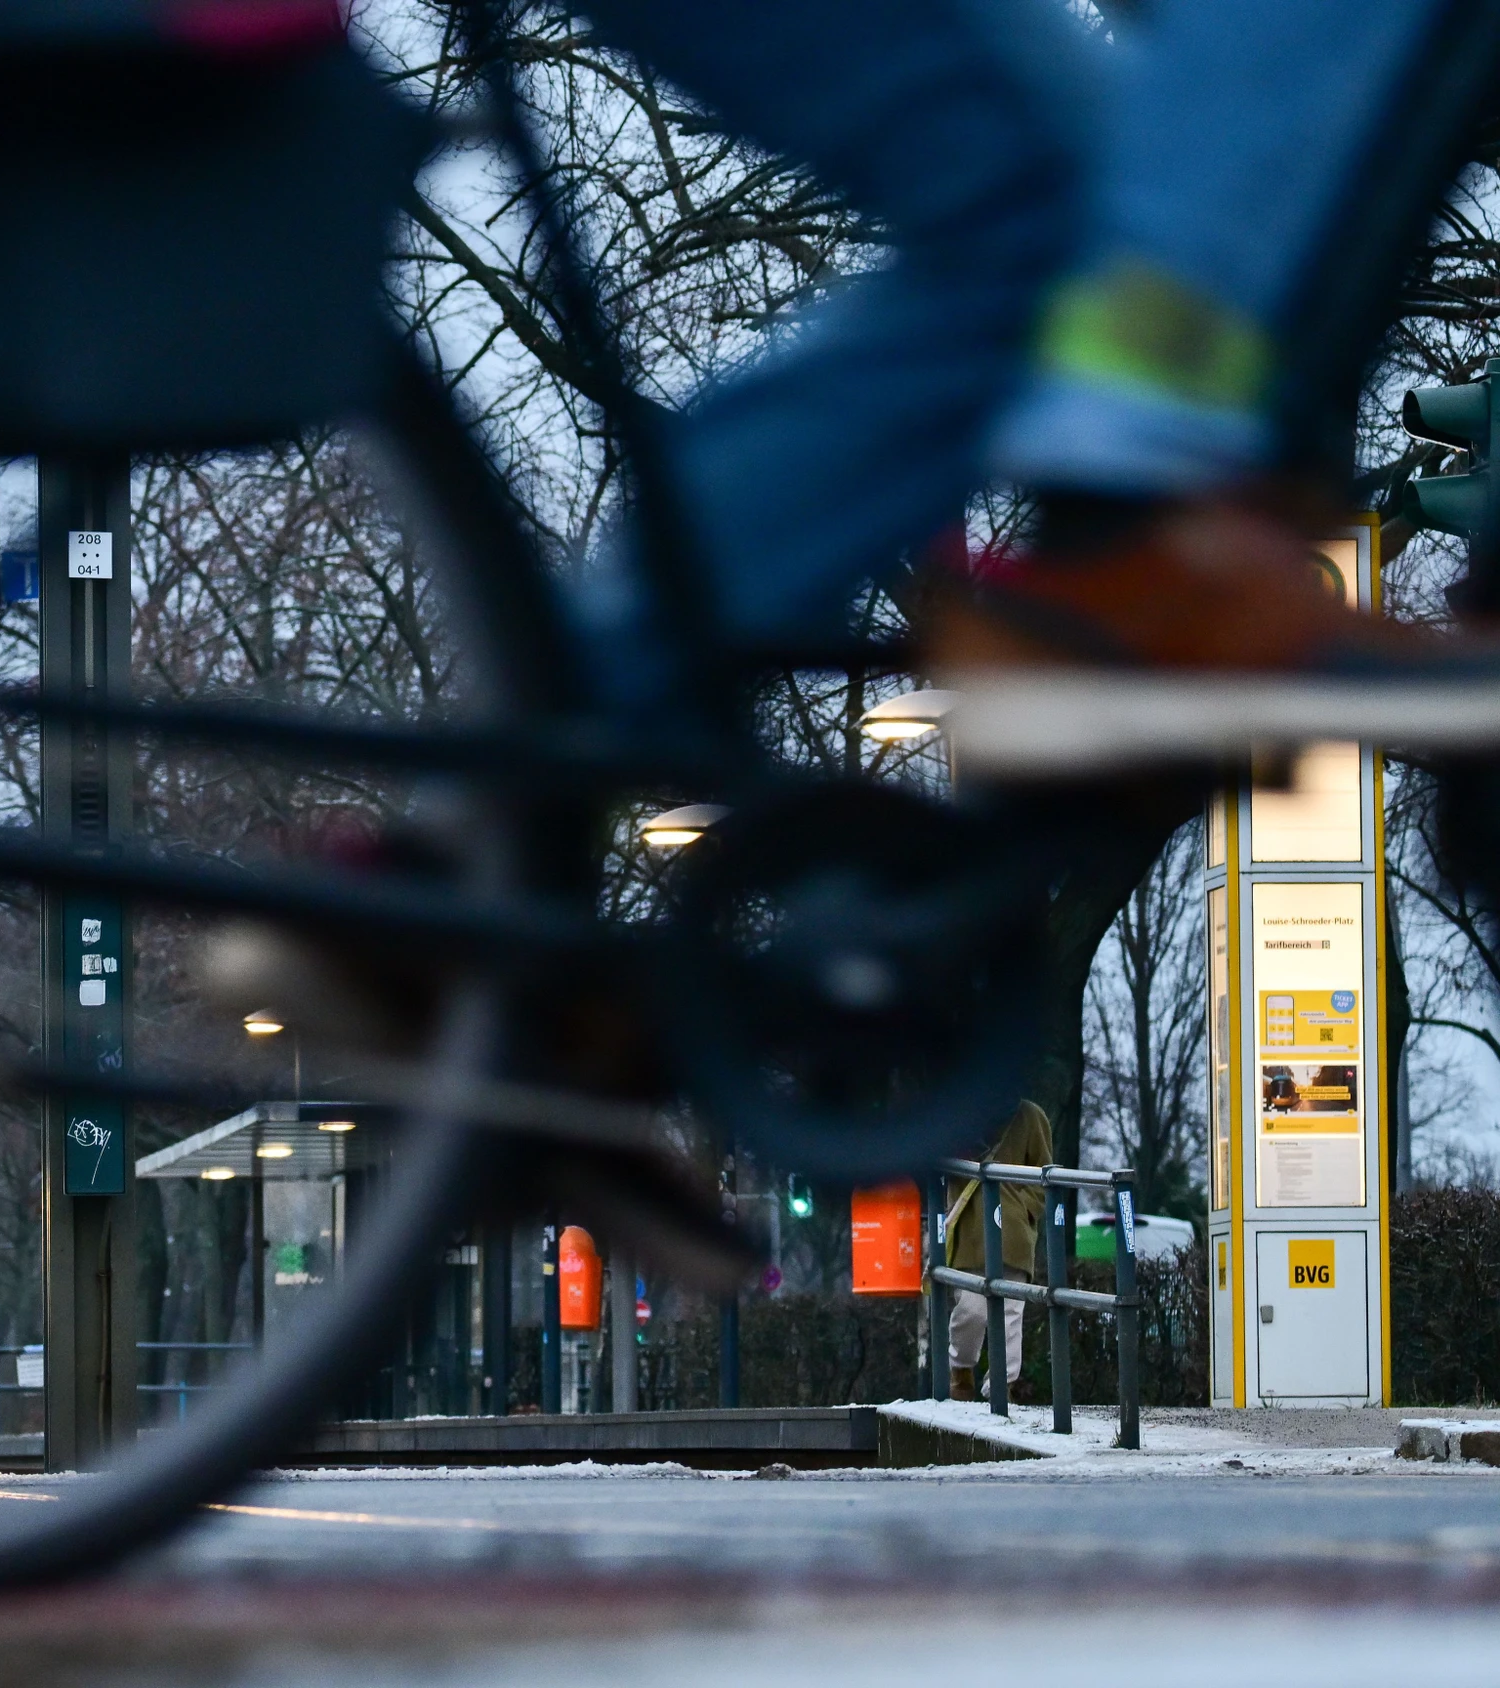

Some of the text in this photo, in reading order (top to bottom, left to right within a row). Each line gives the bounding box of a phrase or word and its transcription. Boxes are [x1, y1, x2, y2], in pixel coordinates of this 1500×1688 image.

[78, 534, 101, 544] 208
[77, 565, 100, 575] 04-1
[1263, 917, 1354, 925] Louise-Schroeder-Platz
[1265, 940, 1312, 949] Tarifbereich
[1294, 1265, 1330, 1284] BVG
